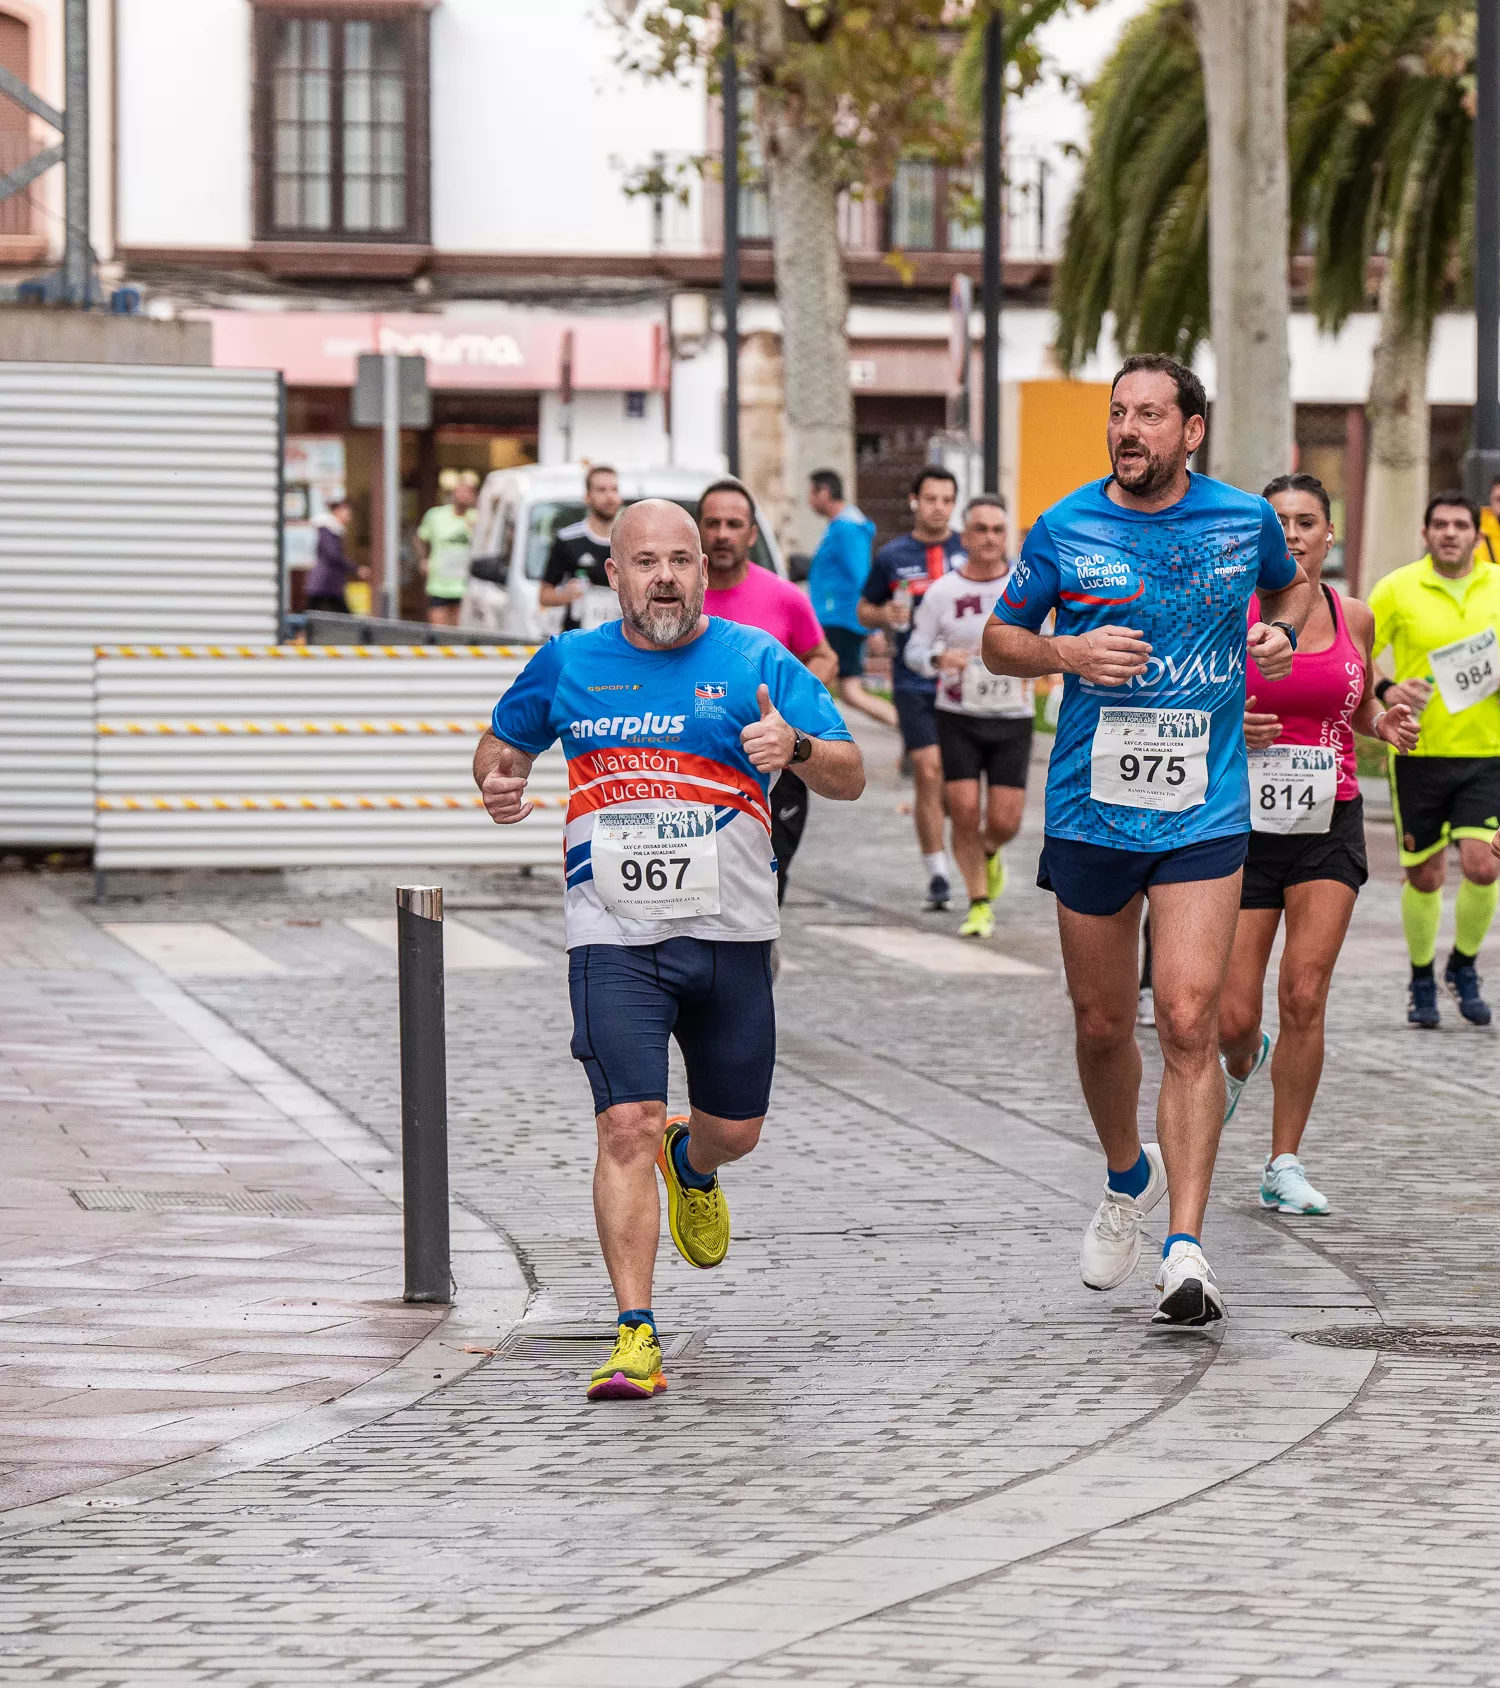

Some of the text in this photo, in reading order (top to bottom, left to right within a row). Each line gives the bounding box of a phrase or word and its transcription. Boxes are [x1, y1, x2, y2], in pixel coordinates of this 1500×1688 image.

[1075, 553, 1105, 567] Club
[1214, 564, 1248, 576] enerplus
[1077, 561, 1131, 580] Maratón
[1080, 575, 1127, 590] Lucena
[1456, 660, 1492, 690] 984
[569, 712, 686, 740] enerplus
[1158, 711, 1187, 724] 2024
[627, 734, 681, 744] directo
[591, 750, 679, 775] Maratón
[1119, 754, 1186, 785] 975
[601, 782, 678, 803] Lucena
[1260, 784, 1316, 810] 814
[657, 811, 688, 825] 2024
[621, 858, 691, 892] 967
